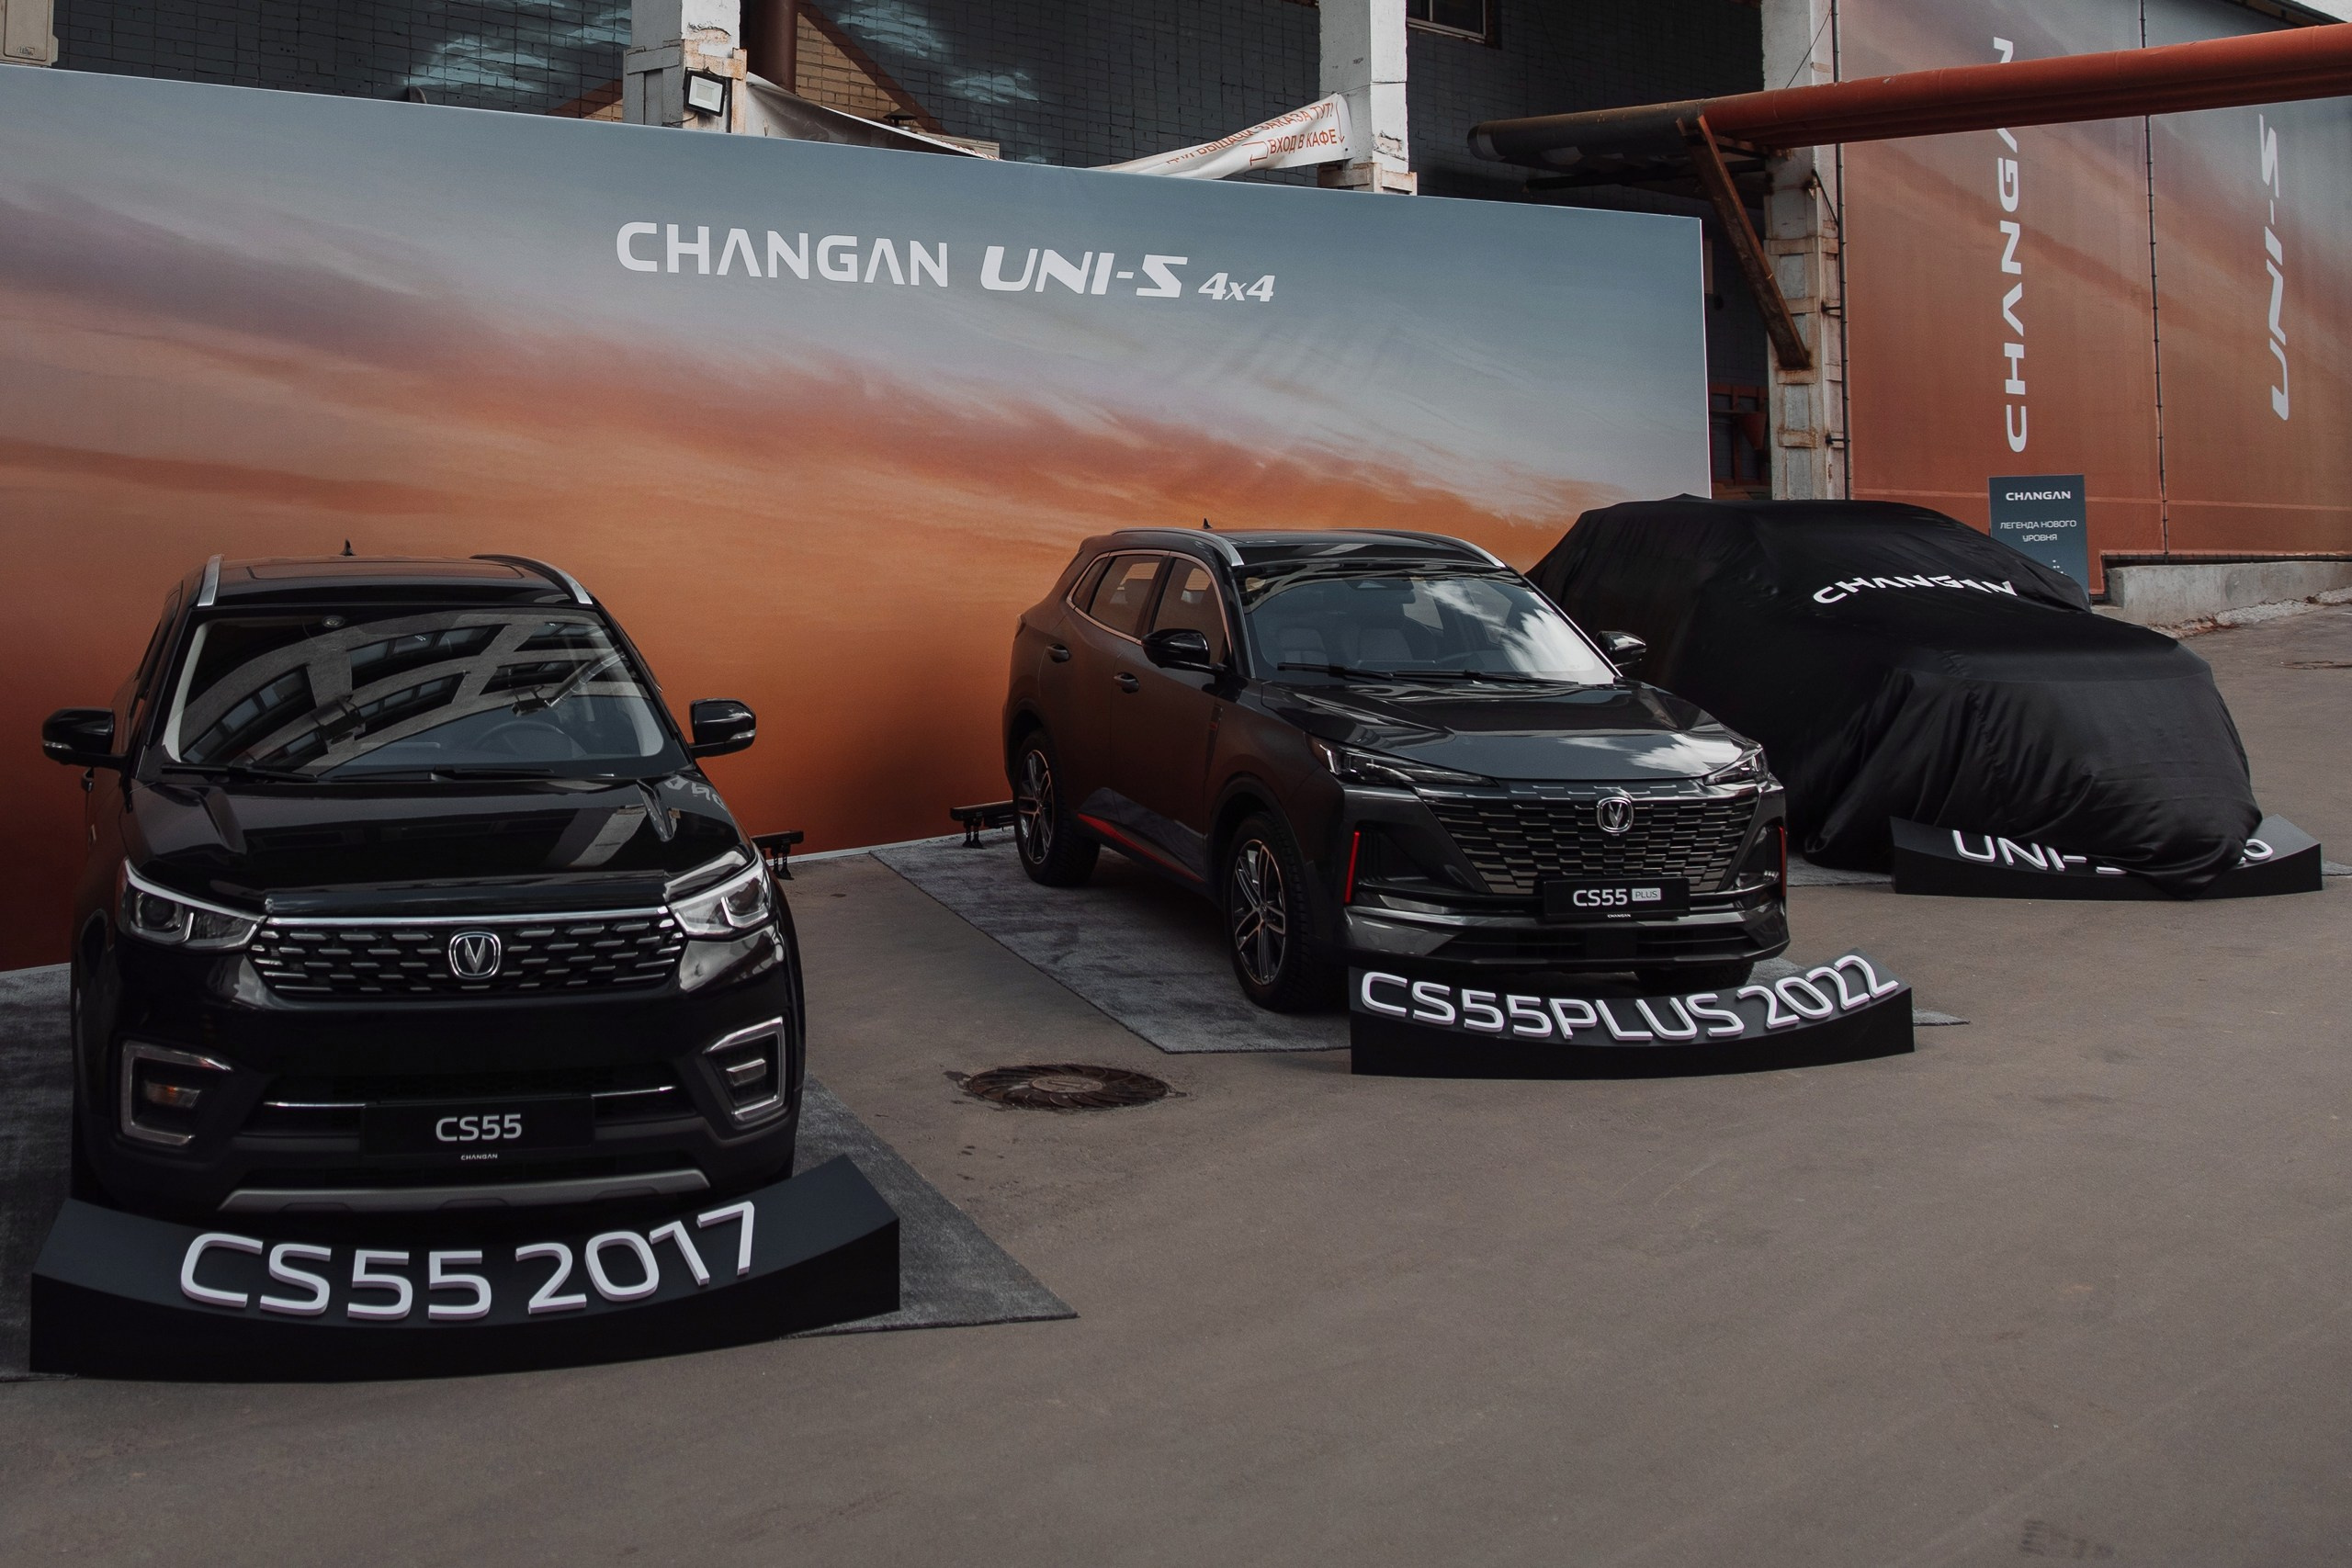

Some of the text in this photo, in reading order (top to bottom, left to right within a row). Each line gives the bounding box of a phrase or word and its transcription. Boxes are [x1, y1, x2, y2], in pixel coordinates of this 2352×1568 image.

[1309, 102, 1334, 119] ТУТ!
[1267, 129, 1338, 154] ВХОД В КАФЕ
[616, 221, 1275, 302] CHANGAN UNI-S 4x4
[2259, 114, 2290, 421] UNI-S
[2005, 491, 2072, 502] CHANGAN
[2000, 519, 2077, 530] ЛЕГЕНДА НОВОГО
[2022, 533, 2058, 543] УРОВНЯ
[1813, 574, 2018, 604] CHANGAN
[1952, 829, 2128, 874] UNI-
[1573, 888, 1658, 908] CS55 PLUS
[1361, 954, 1899, 1041] CS55PLUS 2022
[435, 1113, 523, 1142] CS55
[460, 1153, 498, 1161] CHANGAN
[180, 1200, 756, 1321] CS55 2017
